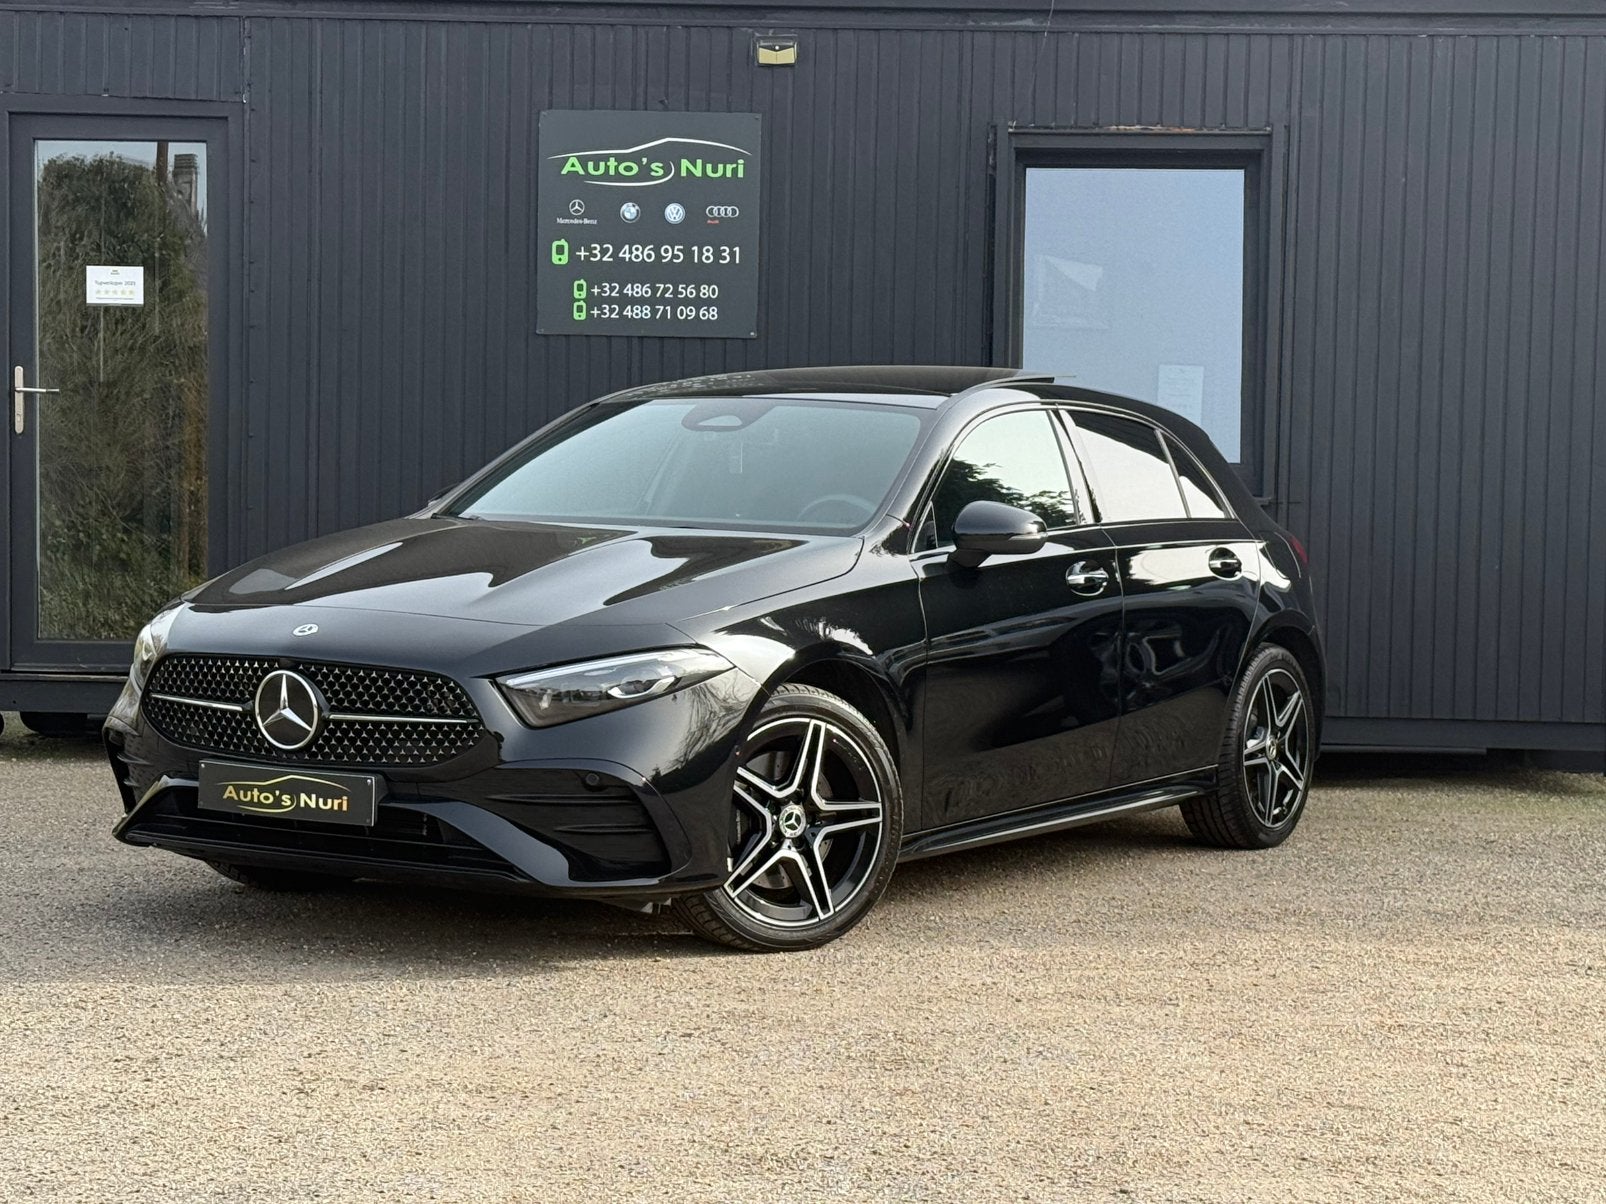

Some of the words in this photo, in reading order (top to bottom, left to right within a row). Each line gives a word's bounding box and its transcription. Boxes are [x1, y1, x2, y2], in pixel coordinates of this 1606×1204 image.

[561, 156, 664, 176] Auto's
[680, 158, 744, 178] Nuri
[576, 244, 614, 262] +32
[618, 244, 655, 263] 486
[660, 245, 684, 263] 95
[691, 246, 714, 264] 18
[719, 246, 741, 264] 31
[590, 283, 619, 297] +32
[623, 283, 652, 298] 486
[655, 284, 674, 298] 72
[677, 284, 696, 298] 56
[699, 285, 719, 299] 80
[590, 304, 619, 319] +32
[622, 305, 651, 319] 488
[655, 305, 671, 319] 71
[677, 306, 696, 320] 09
[699, 306, 718, 320] 68
[222, 785, 292, 806] Auto's
[300, 793, 348, 812] Nuri
